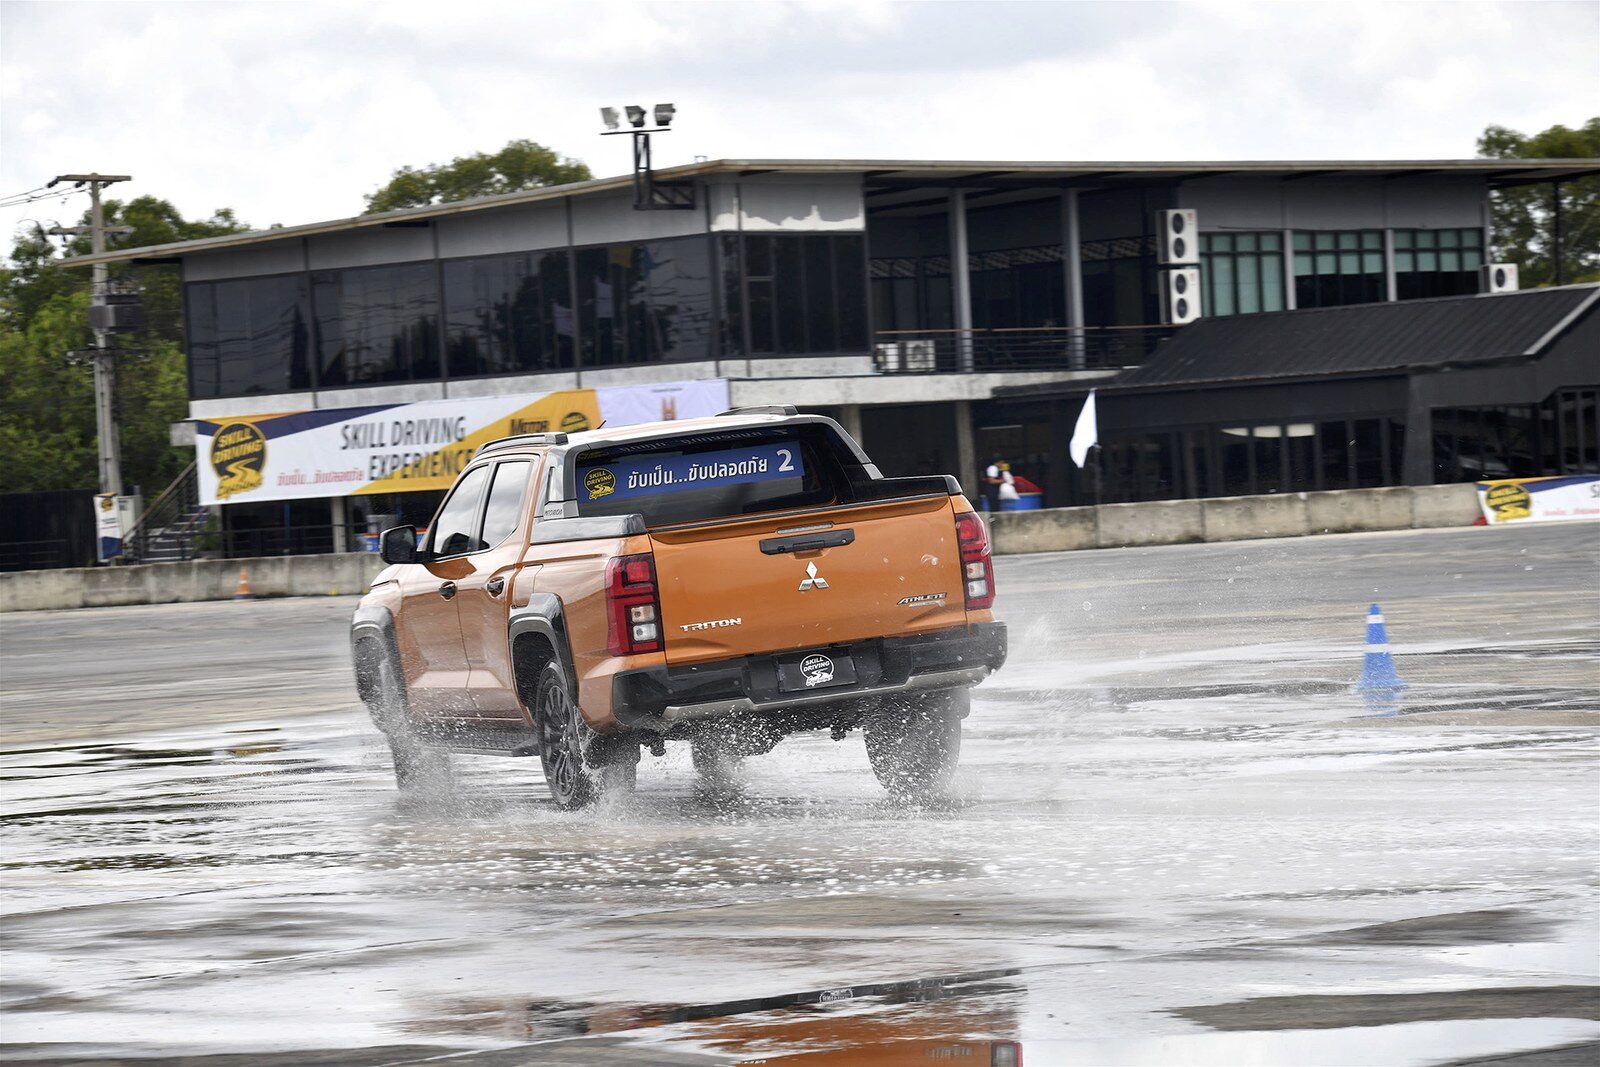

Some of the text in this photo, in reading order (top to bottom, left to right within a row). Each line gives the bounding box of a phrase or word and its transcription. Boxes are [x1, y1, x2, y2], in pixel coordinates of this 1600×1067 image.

[341, 416, 465, 450] SKILL DRIVING
[627, 449, 794, 489] ขับเป็น...ขับปลอดภัย 2
[587, 474, 612, 486] DRIVING
[589, 471, 605, 480] SKILL
[897, 592, 947, 605] ATHLETE
[680, 618, 741, 632] TRITON
[803, 661, 830, 672] DRIVING
[805, 657, 823, 666] SKILL
